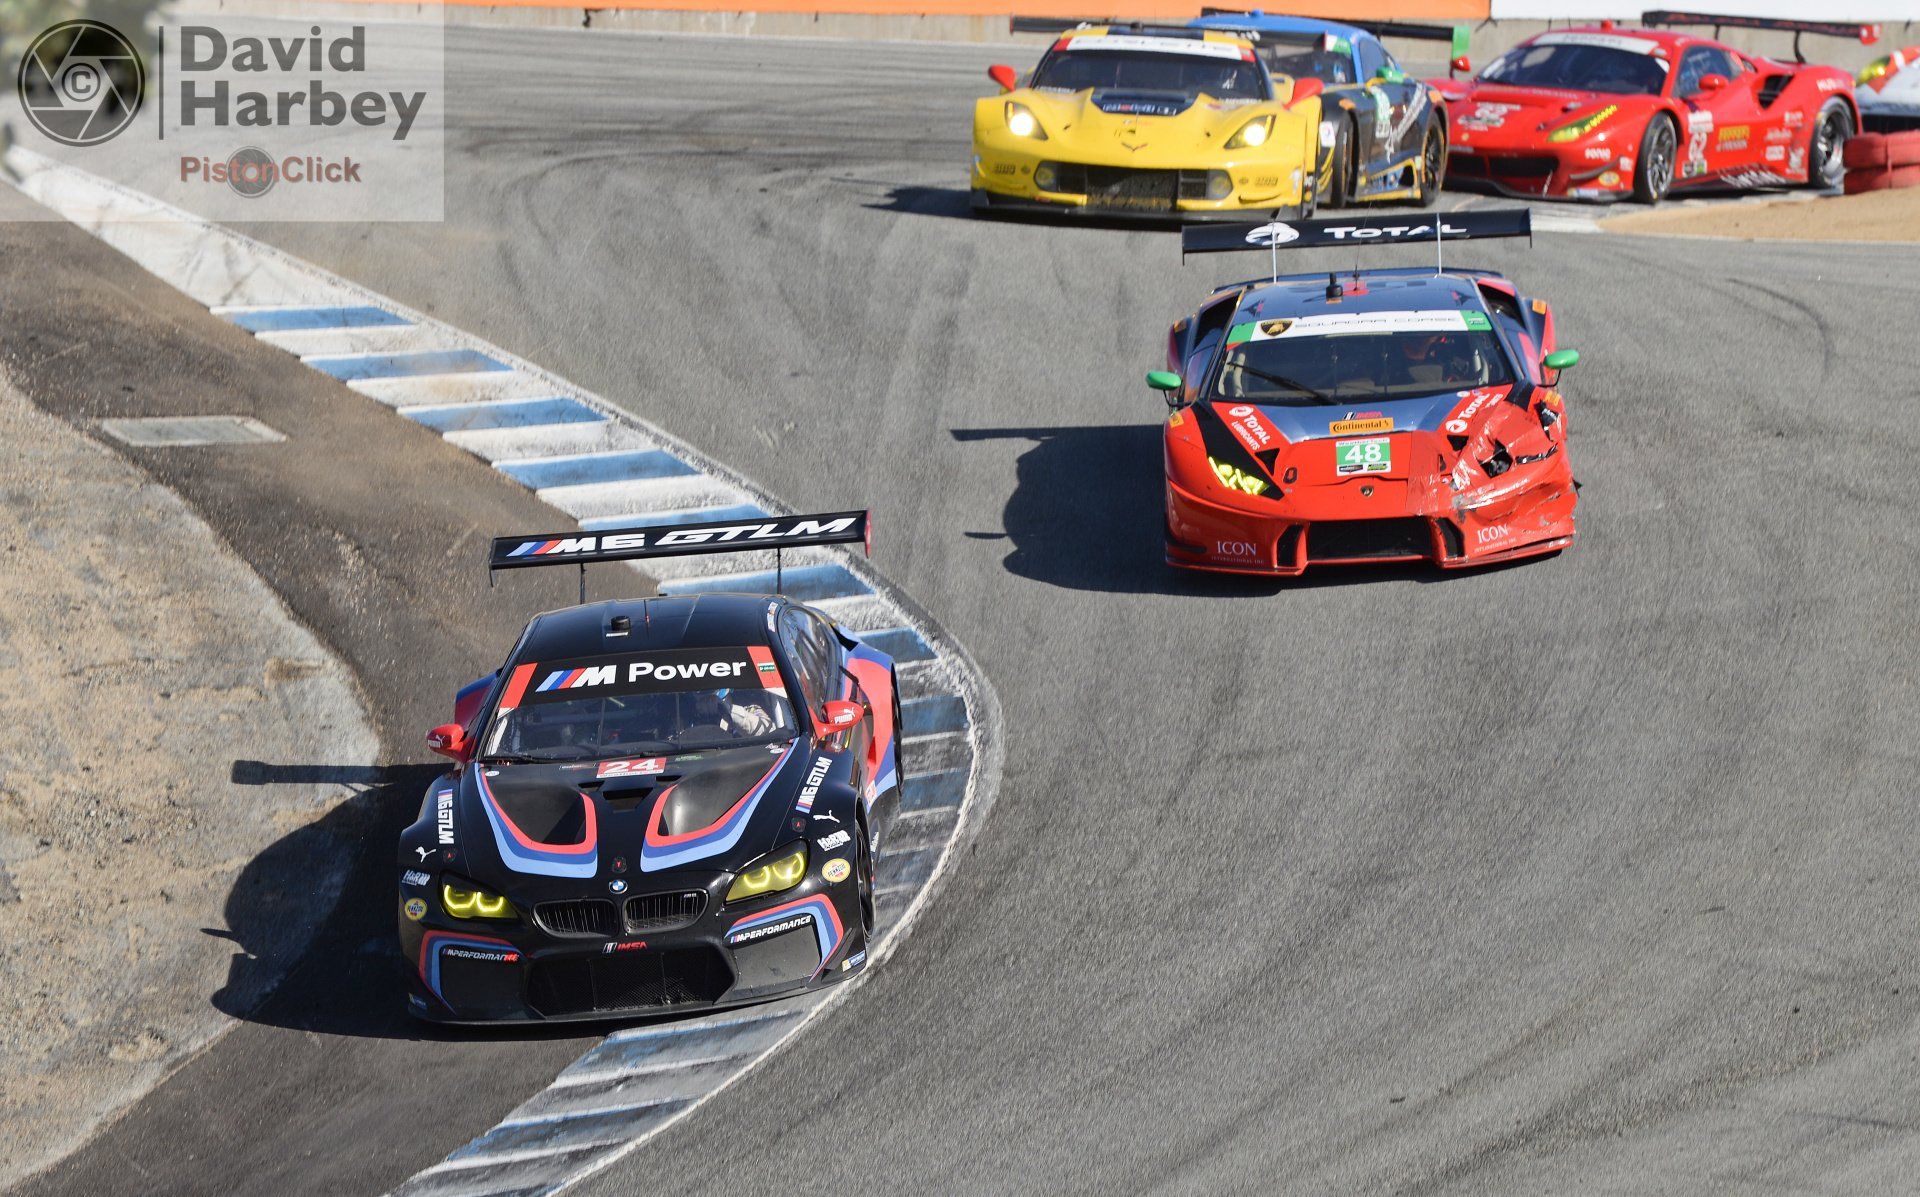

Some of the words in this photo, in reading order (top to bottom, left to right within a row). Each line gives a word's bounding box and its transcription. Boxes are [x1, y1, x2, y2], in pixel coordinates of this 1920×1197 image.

[1323, 224, 1468, 239] TOTAL
[1458, 393, 1491, 420] TOTAL
[1243, 414, 1271, 445] TOTAL
[1332, 420, 1382, 433] Continental
[1344, 443, 1382, 464] 48
[653, 517, 857, 546] GTLM
[1477, 523, 1510, 545] ICON
[1216, 540, 1257, 556] ICON
[628, 661, 747, 683] Power
[604, 758, 659, 775] 24
